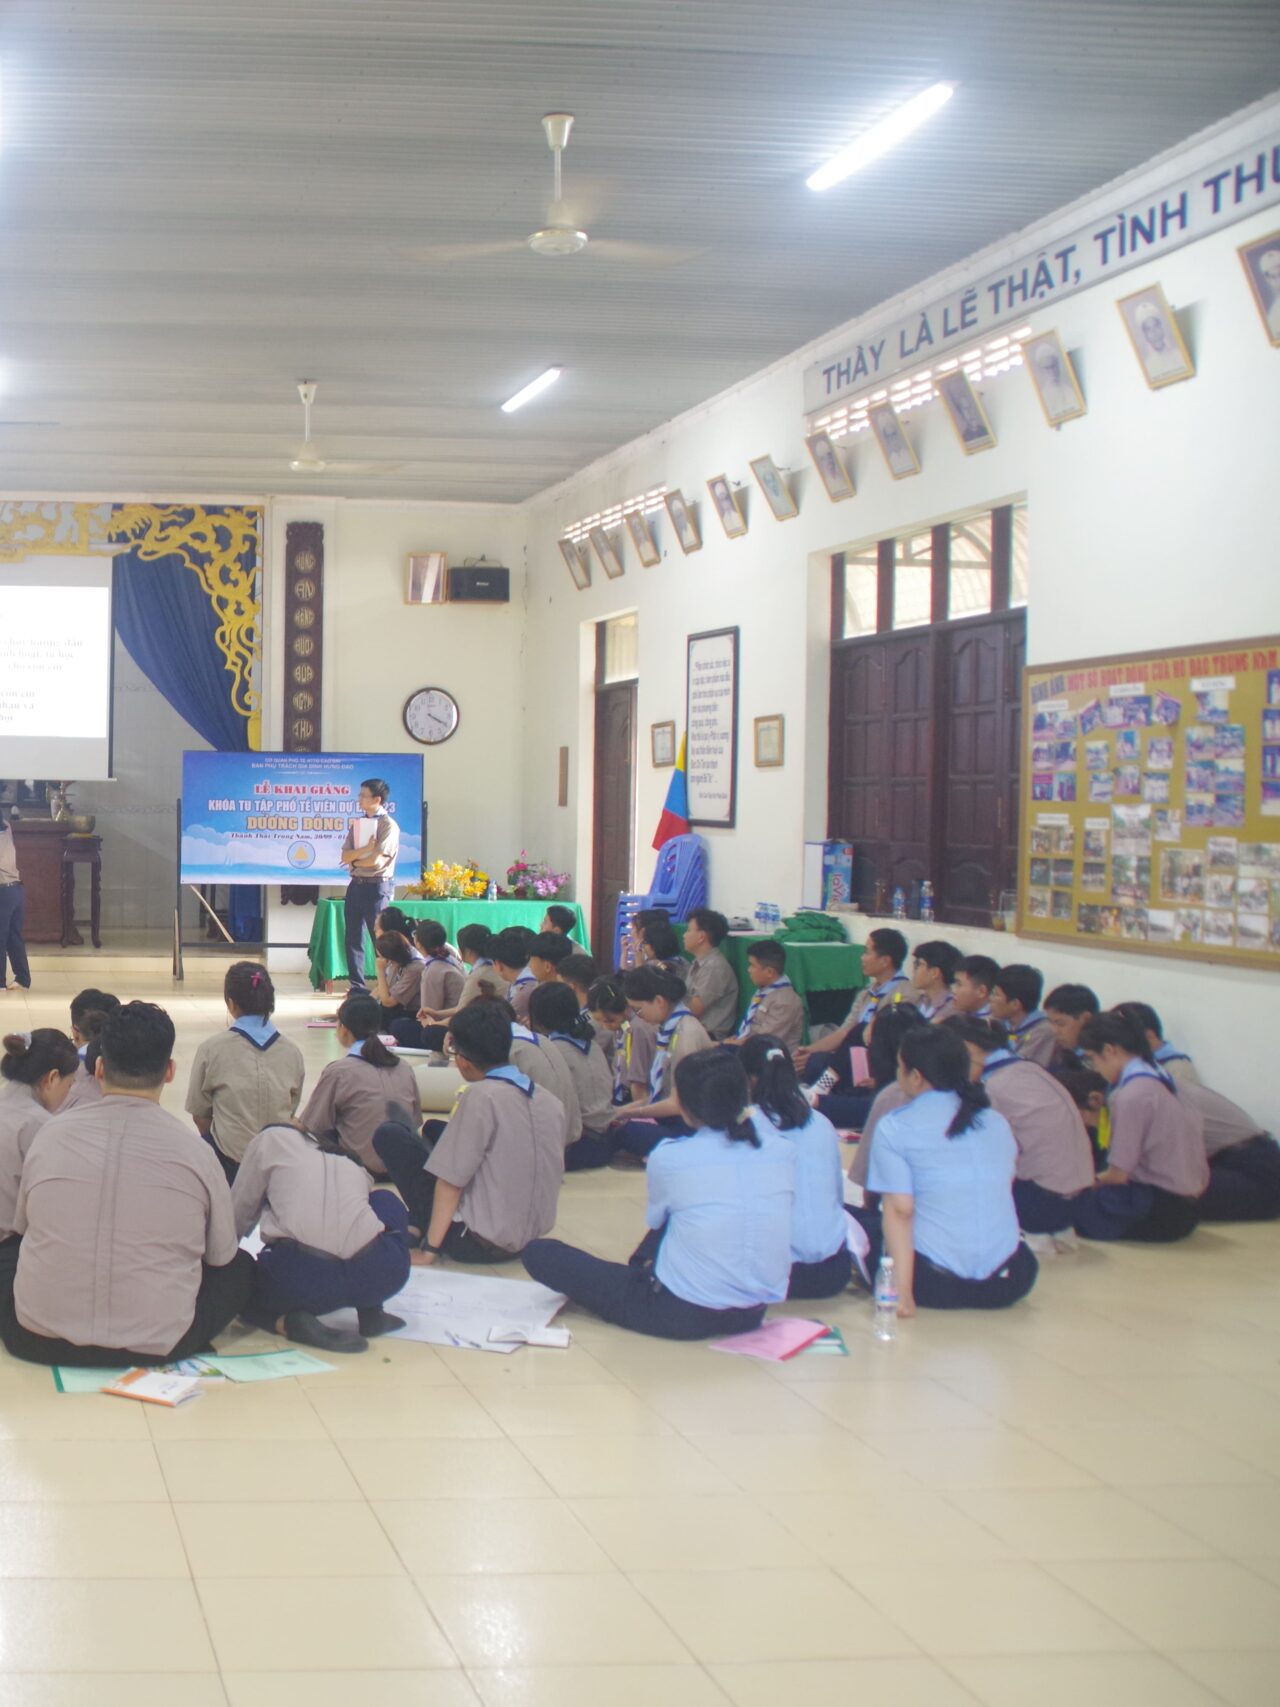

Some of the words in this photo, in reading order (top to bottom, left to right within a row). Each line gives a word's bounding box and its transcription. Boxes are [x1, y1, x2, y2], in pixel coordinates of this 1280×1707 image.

[899, 312, 934, 359] LÀ
[1093, 190, 1188, 266] TÌNH
[255, 780, 270, 794] LỄ
[274, 784, 307, 795] KHAI
[310, 783, 350, 796] GIẢNG
[239, 800, 252, 812] TU
